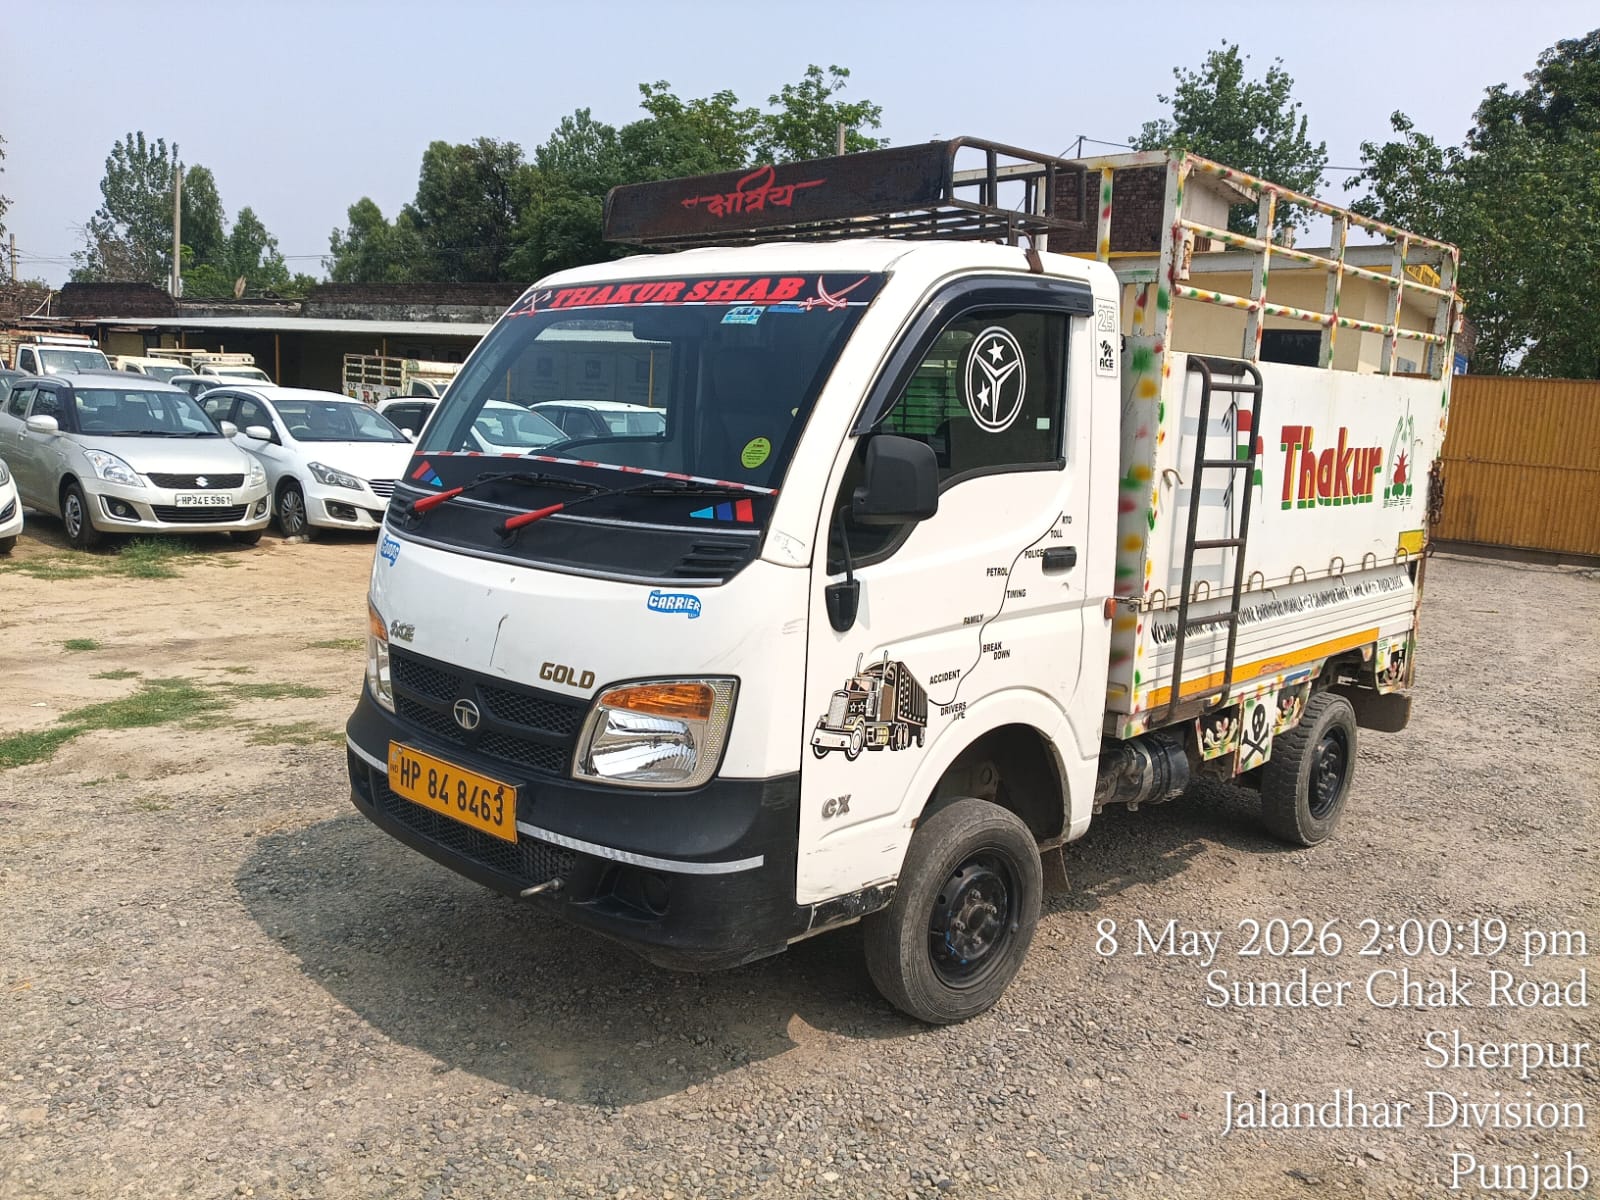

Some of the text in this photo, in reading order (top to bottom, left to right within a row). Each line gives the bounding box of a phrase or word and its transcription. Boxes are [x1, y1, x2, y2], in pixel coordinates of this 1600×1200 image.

[549, 277, 805, 308] THAKUR SHAB
[1099, 358, 1113, 368] ACE
[1281, 425, 1383, 510] Thakur
[1062, 515, 1072, 524] RTO
[1050, 529, 1063, 539] TOLL
[1024, 548, 1044, 559] POLICE
[986, 567, 1008, 576] PETROL
[1007, 589, 1026, 599] TIMING
[648, 595, 701, 612] CARRIER
[963, 614, 984, 625] FAMILY
[982, 641, 1003, 653] BREAK
[993, 649, 1011, 660] DOWN
[539, 661, 595, 689] GOLD
[929, 669, 960, 685] ACCIDENT
[940, 702, 966, 716] DRIVERS
[400, 756, 504, 826] HP 84 8463
[821, 794, 852, 819] CX
